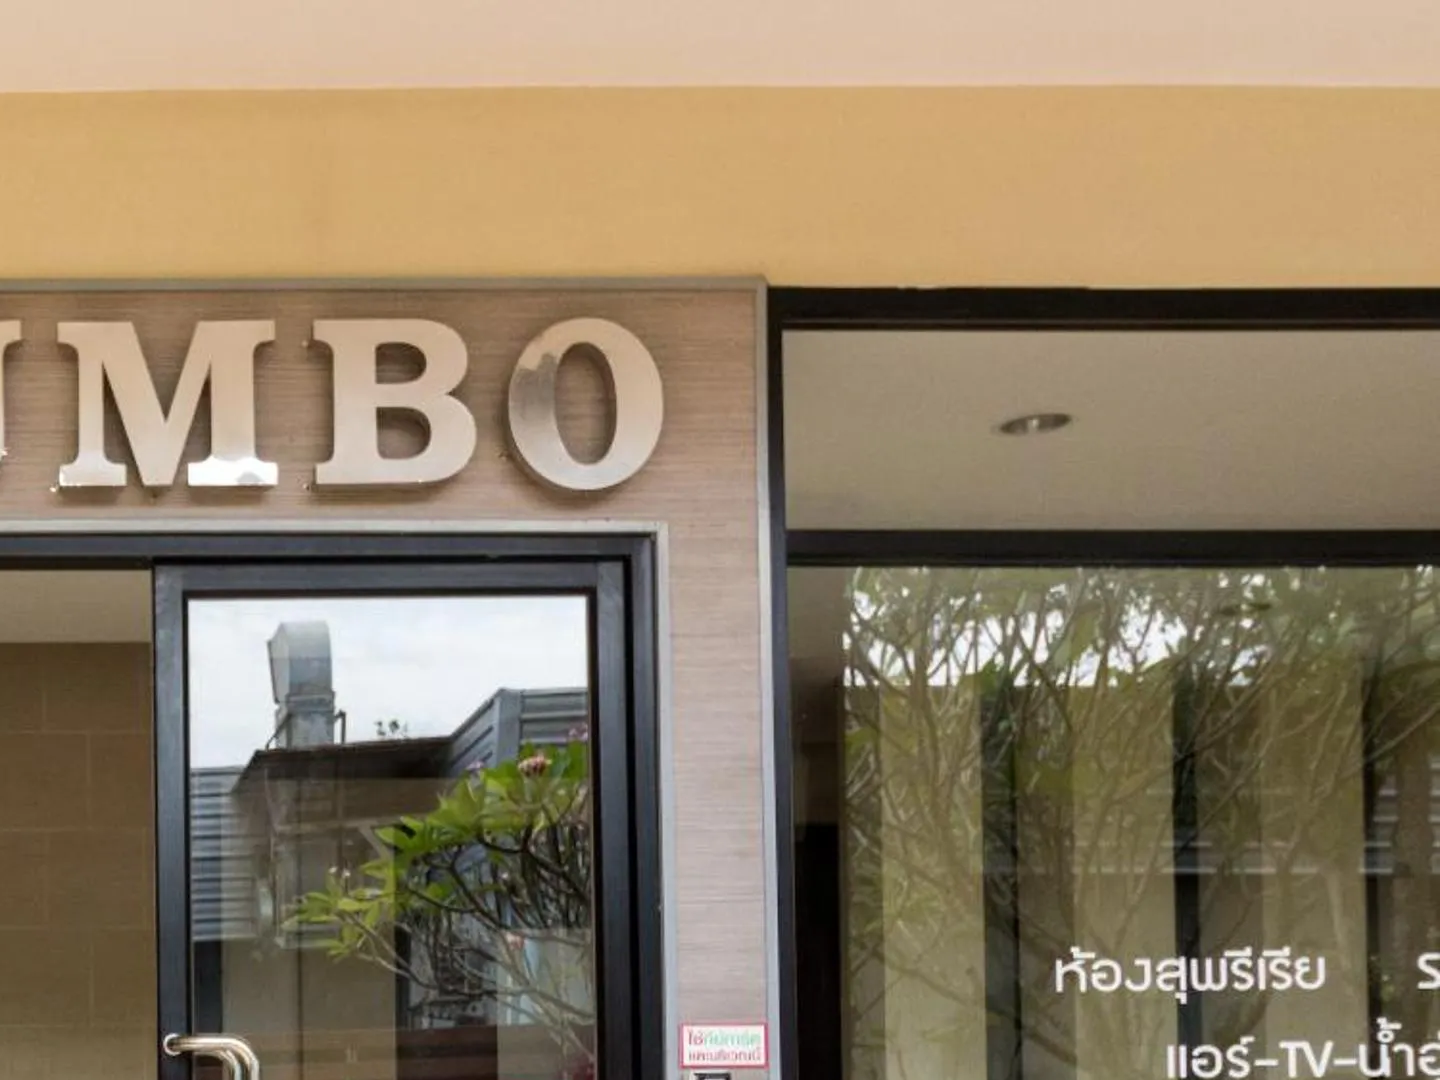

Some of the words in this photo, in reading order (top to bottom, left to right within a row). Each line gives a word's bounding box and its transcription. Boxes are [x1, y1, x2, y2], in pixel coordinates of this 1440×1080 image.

[1055, 945, 1326, 1005] ห้องสุพรีเรีย
